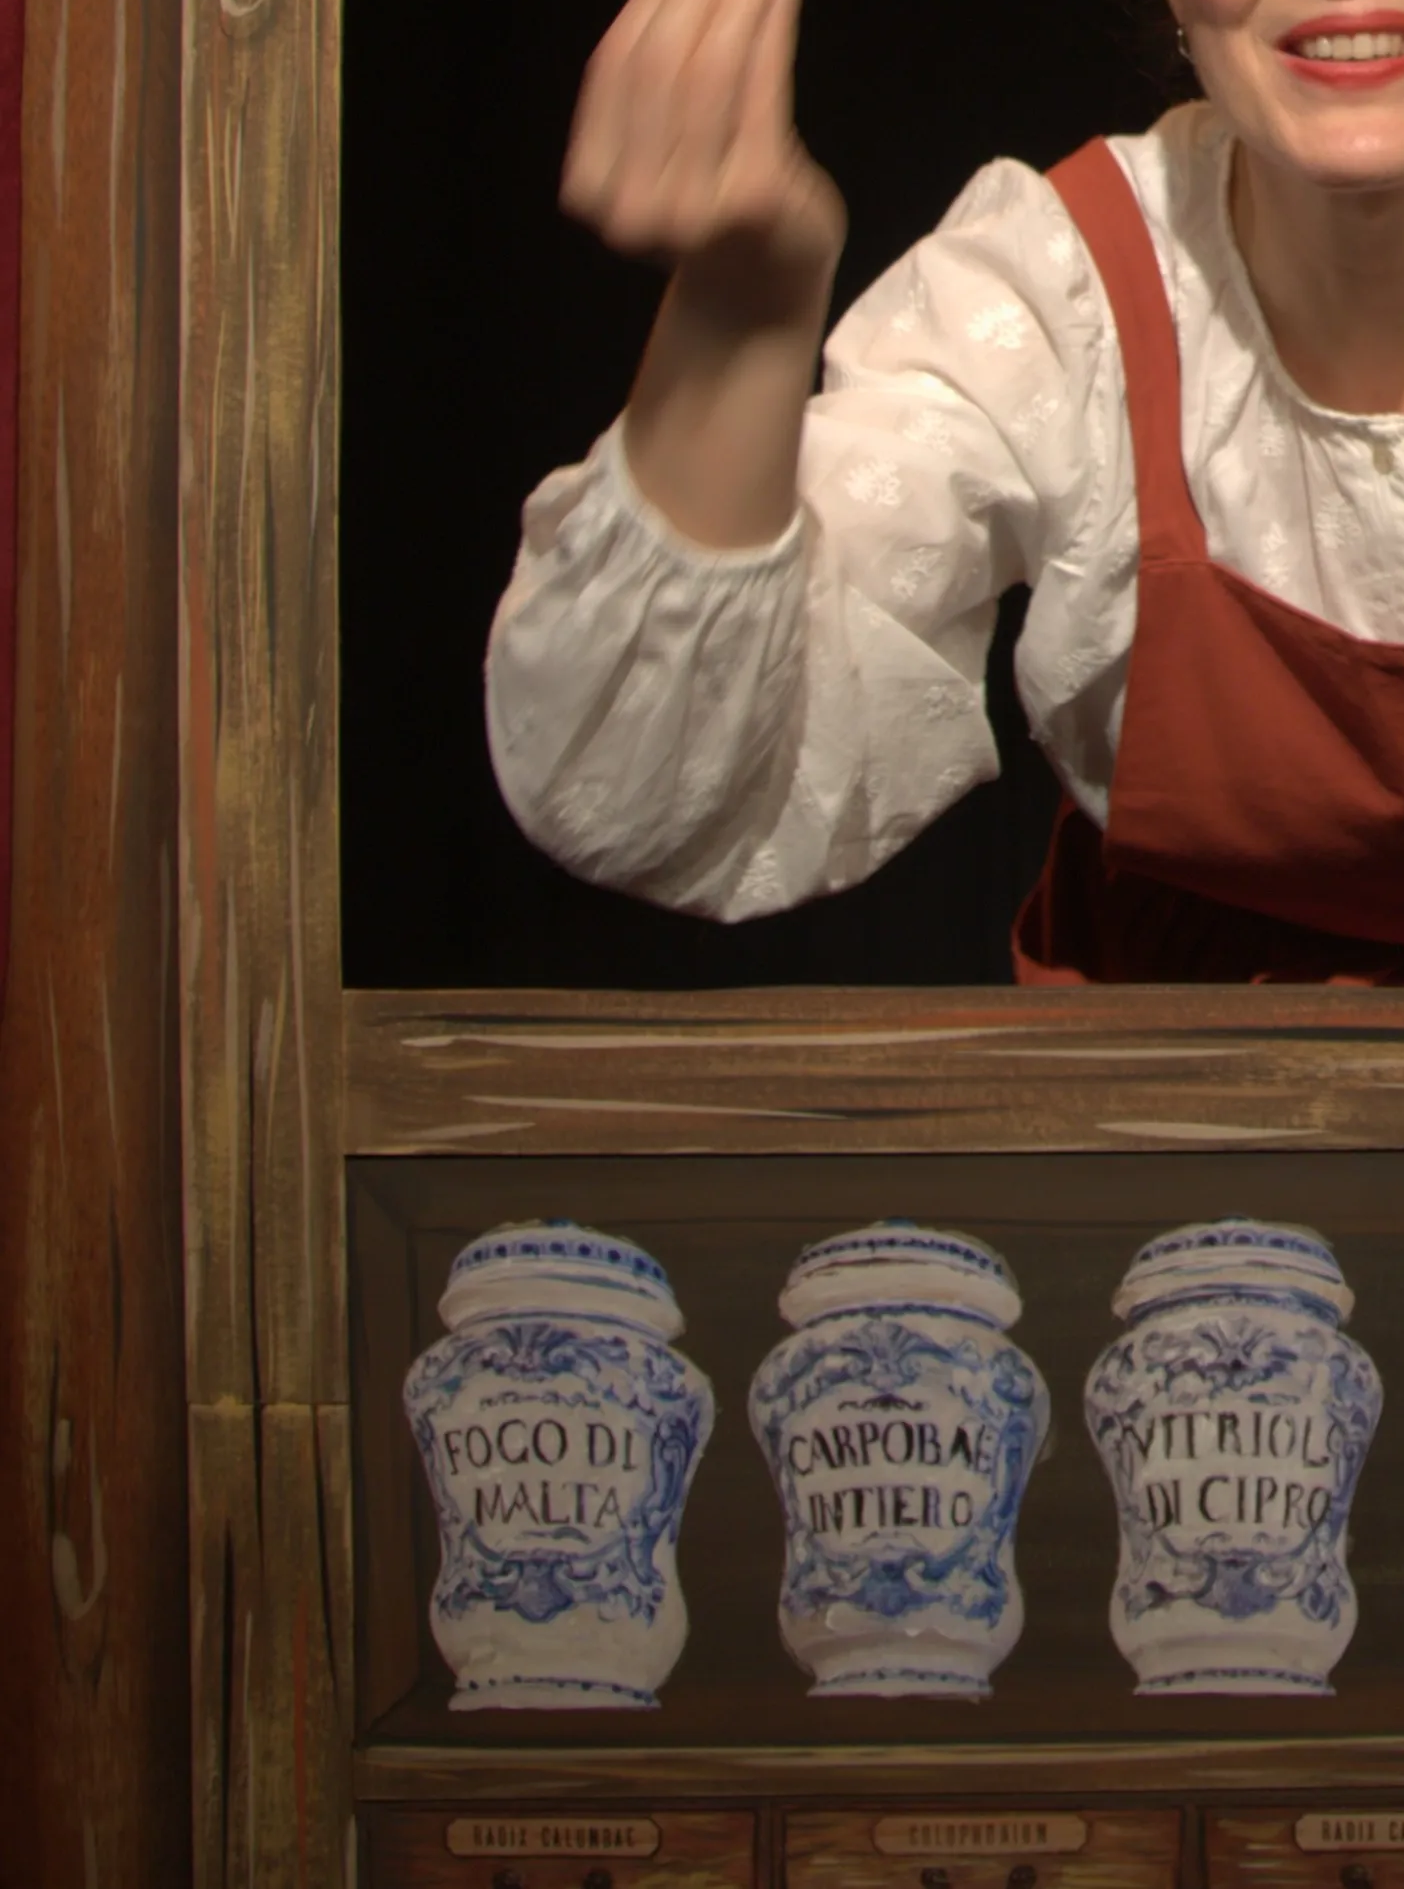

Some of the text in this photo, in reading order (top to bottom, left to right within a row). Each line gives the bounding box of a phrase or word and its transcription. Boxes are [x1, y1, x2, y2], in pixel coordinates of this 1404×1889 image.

[587, 1421, 639, 1473] DI
[473, 1480, 626, 1529] MALTA
[808, 1484, 975, 1534] INTIERO
[1145, 1474, 1332, 1532] DI CIPRO
[1321, 1820, 1375, 1842] RADIX
